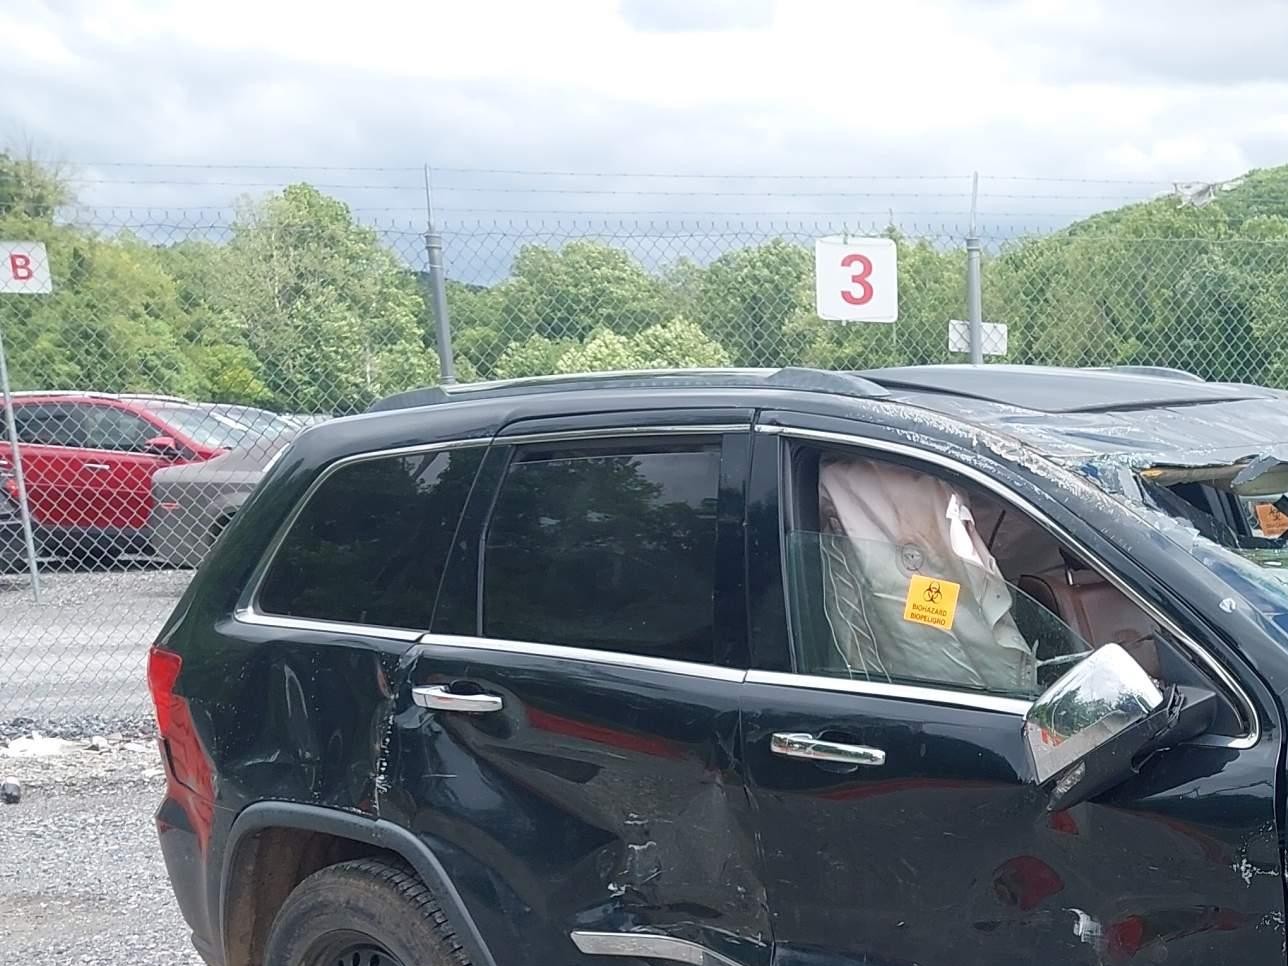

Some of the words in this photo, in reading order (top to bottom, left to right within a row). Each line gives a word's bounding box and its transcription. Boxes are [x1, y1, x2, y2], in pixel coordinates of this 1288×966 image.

[10, 254, 33, 280] B
[840, 254, 874, 306] 3
[910, 612, 946, 626] BIOPELIGRO
[912, 603, 948, 617] BIOHAZARD
